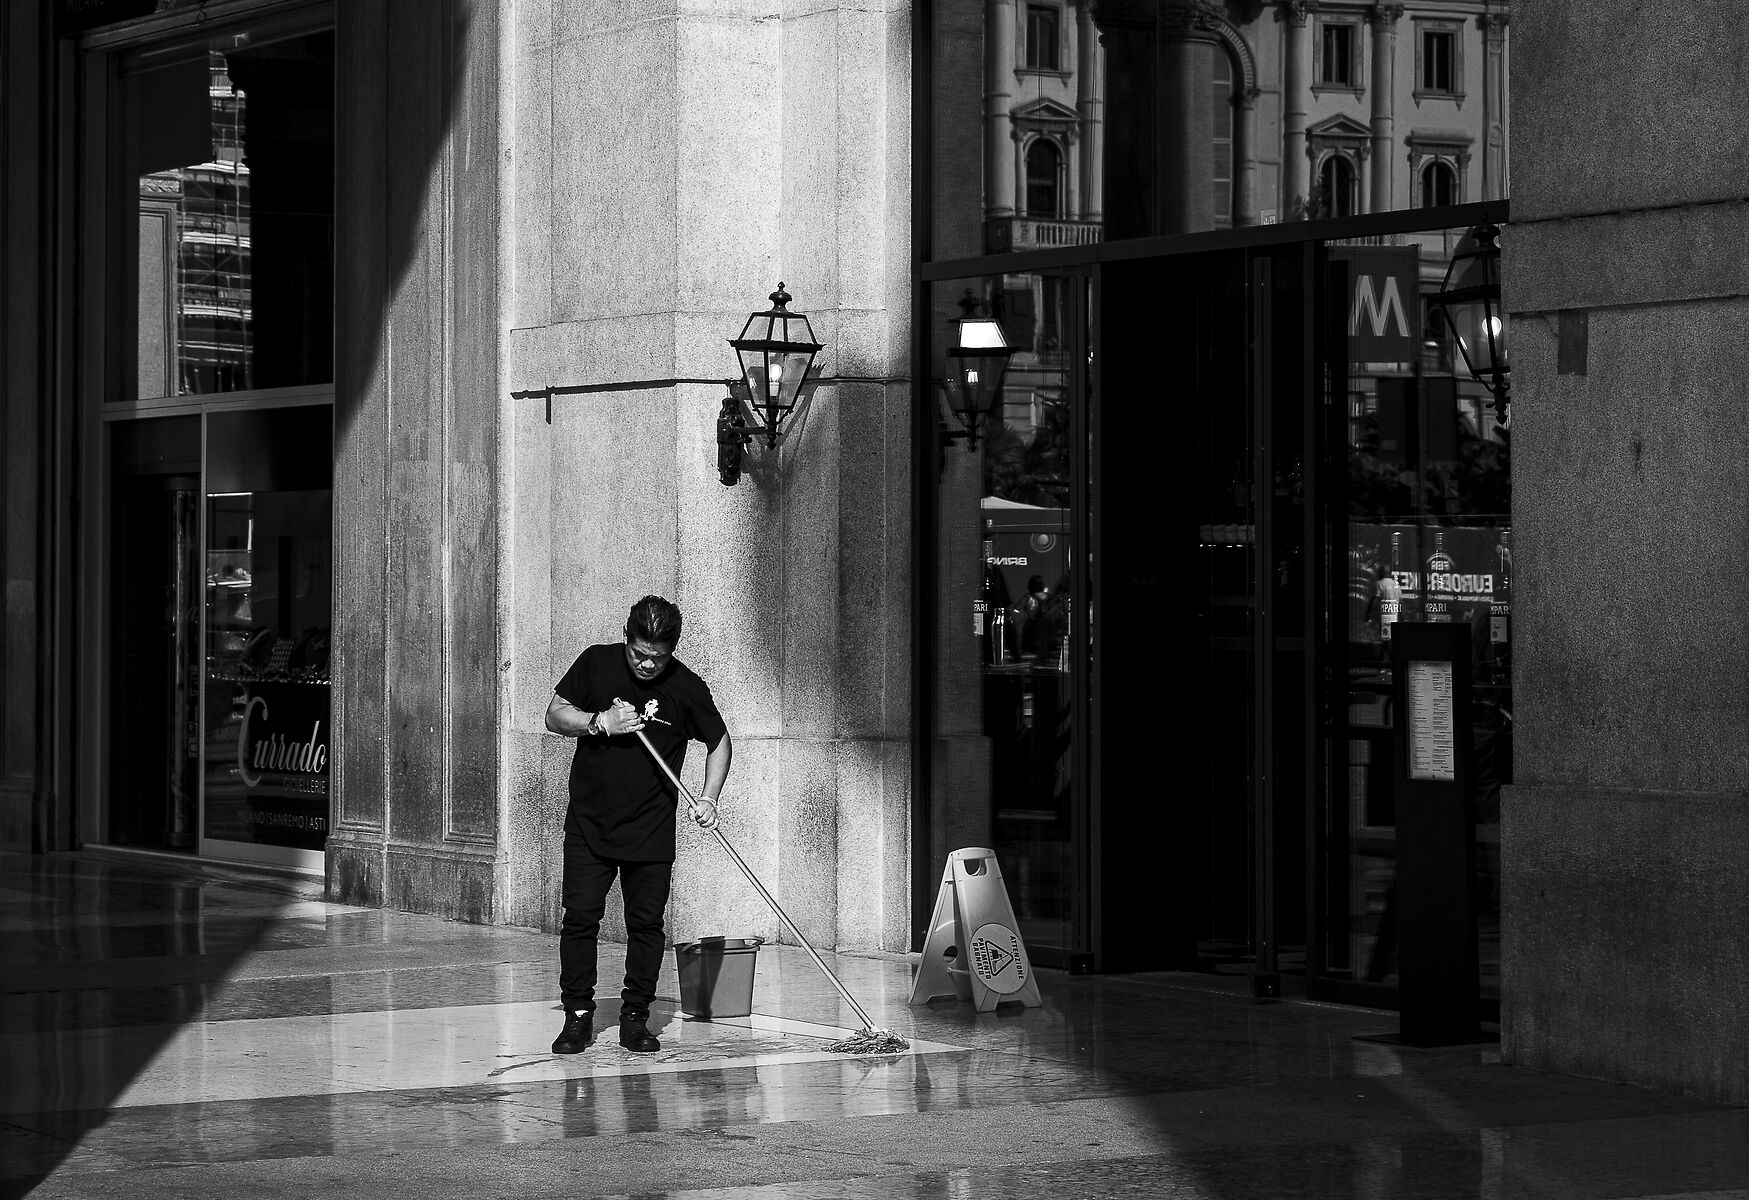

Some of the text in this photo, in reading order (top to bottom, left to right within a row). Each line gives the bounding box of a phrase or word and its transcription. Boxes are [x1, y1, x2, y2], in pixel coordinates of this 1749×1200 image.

[238, 696, 327, 787] Currado
[282, 777, 326, 795] GOELLERIE
[237, 808, 265, 825] MLANO
[972, 942, 985, 976] BAGNATO
[978, 937, 992, 980] PAVIMENTO
[1010, 935, 1025, 980] ATTENZIONE
